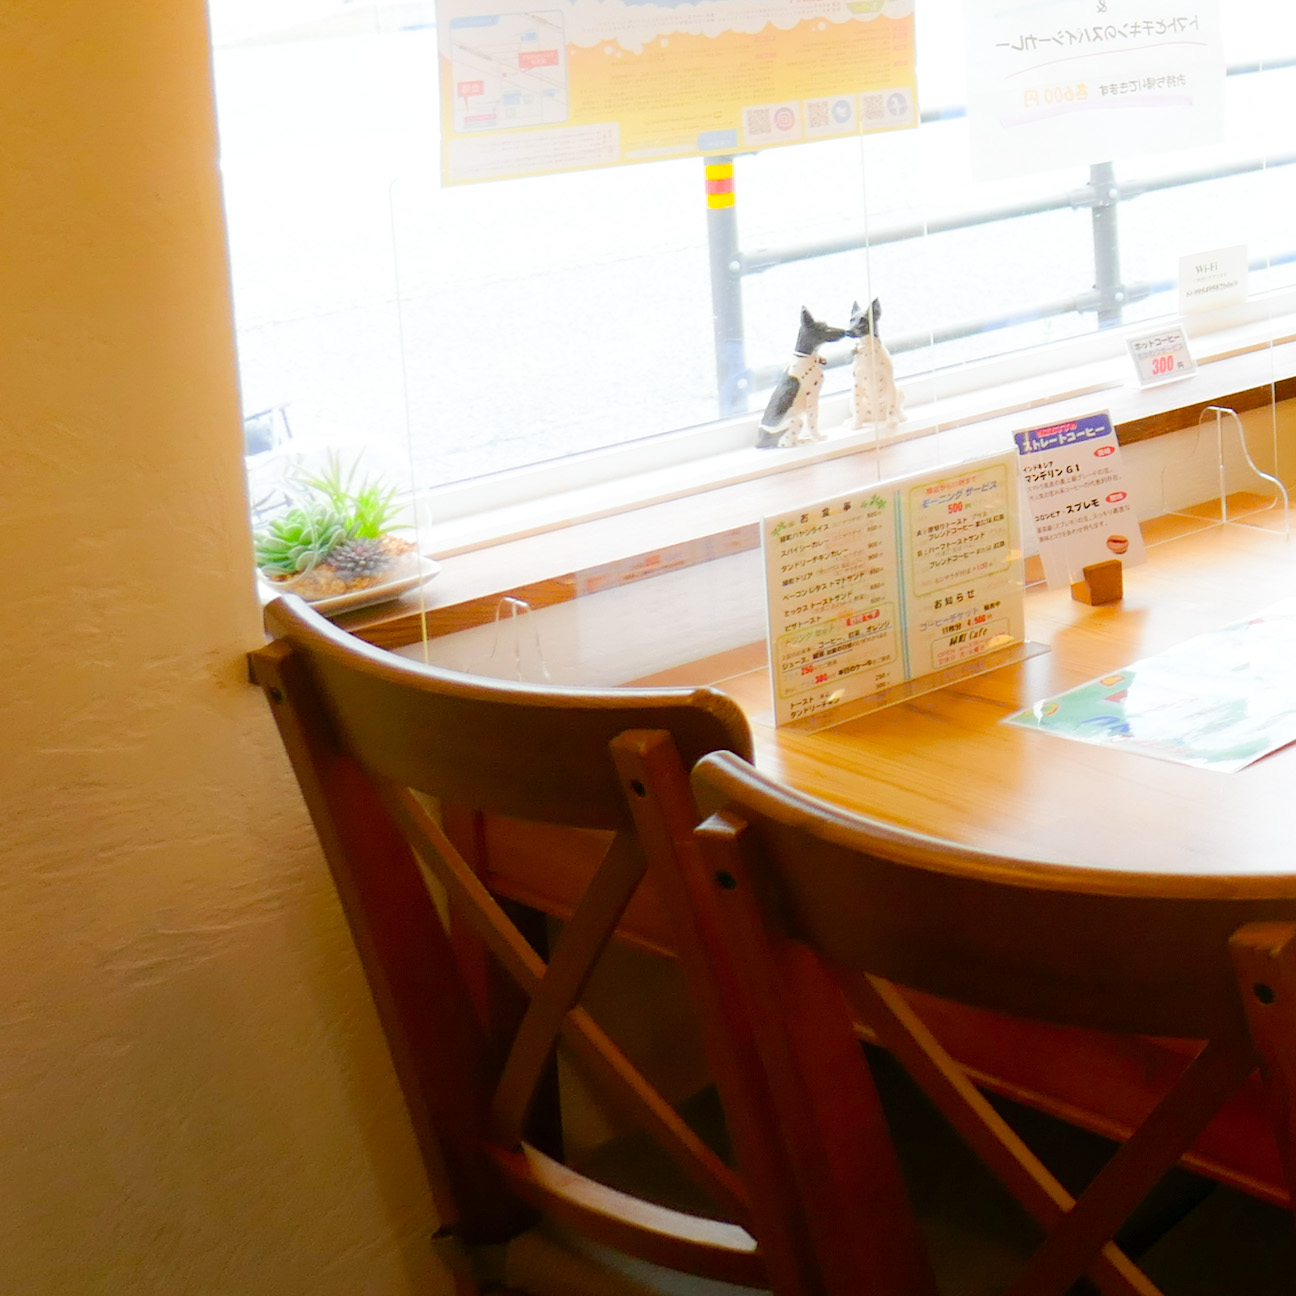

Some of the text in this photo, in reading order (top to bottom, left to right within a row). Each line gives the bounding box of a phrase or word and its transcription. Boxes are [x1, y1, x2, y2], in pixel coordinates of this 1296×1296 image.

[1134, 335, 1181, 351] ホットコーヒー
[1152, 354, 1174, 375] 300
[1023, 426, 1106, 452] ストレートコーヒー
[1024, 468, 1063, 483] マンデリン
[947, 501, 964, 515] 500
